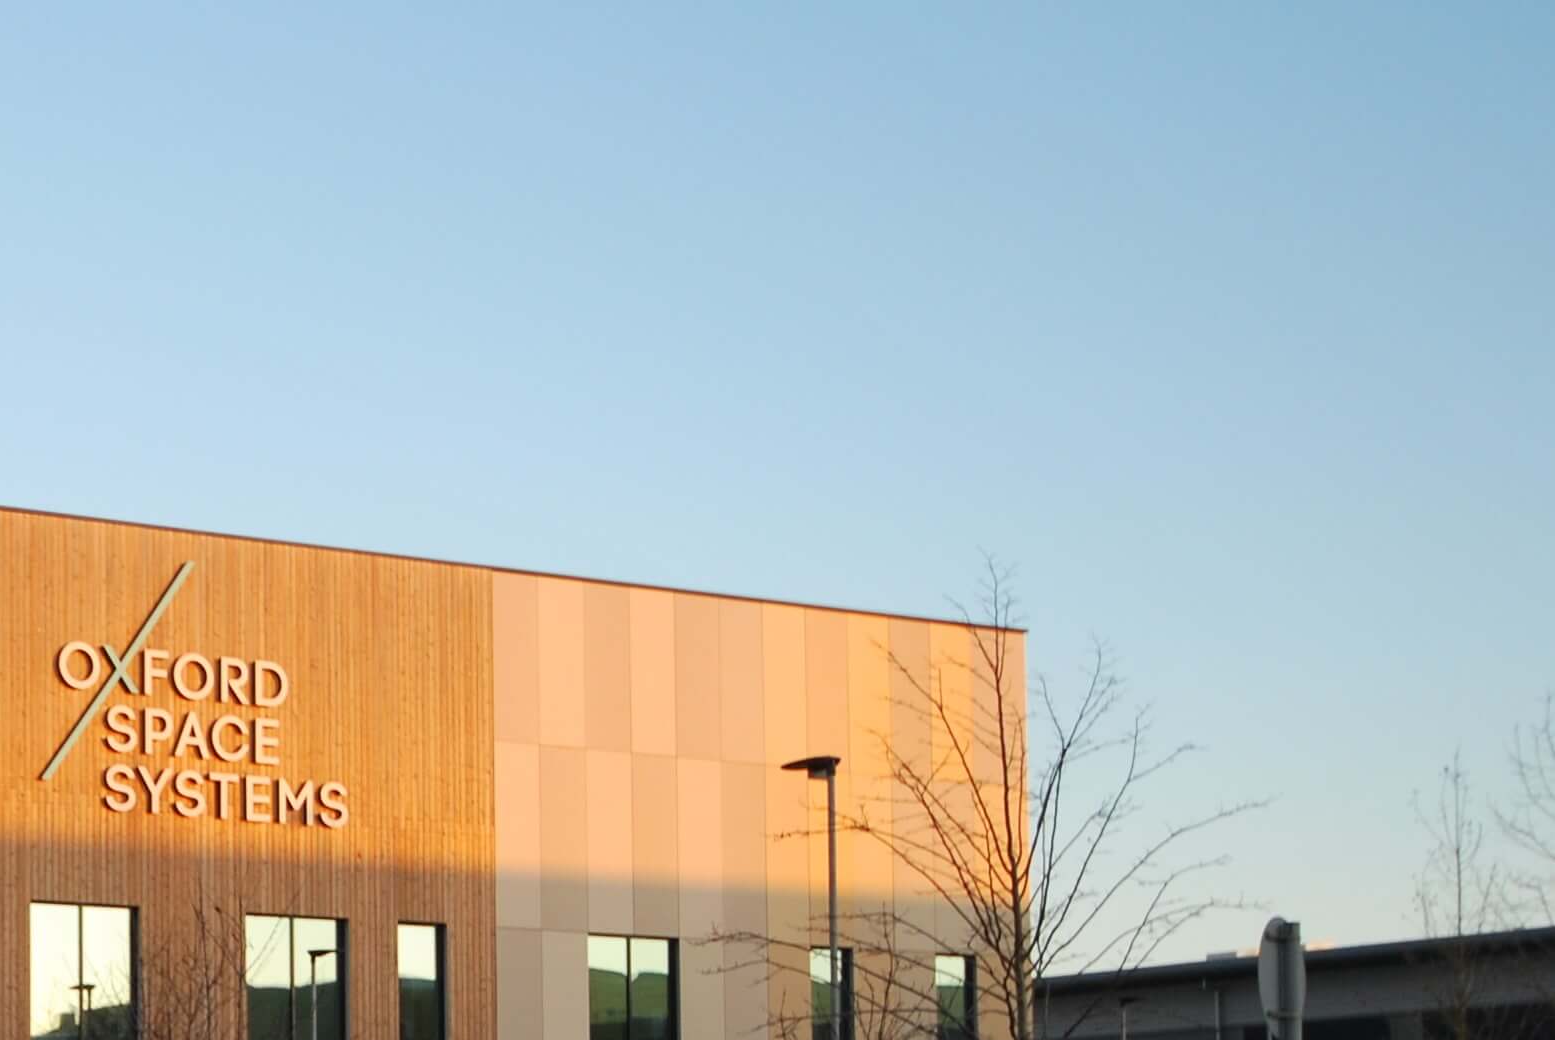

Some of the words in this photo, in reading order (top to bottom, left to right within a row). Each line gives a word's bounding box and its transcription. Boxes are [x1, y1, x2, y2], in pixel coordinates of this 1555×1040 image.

[56, 640, 289, 708] OXFORD
[102, 704, 280, 766] SPACE
[102, 763, 350, 829] SYSTEMS
